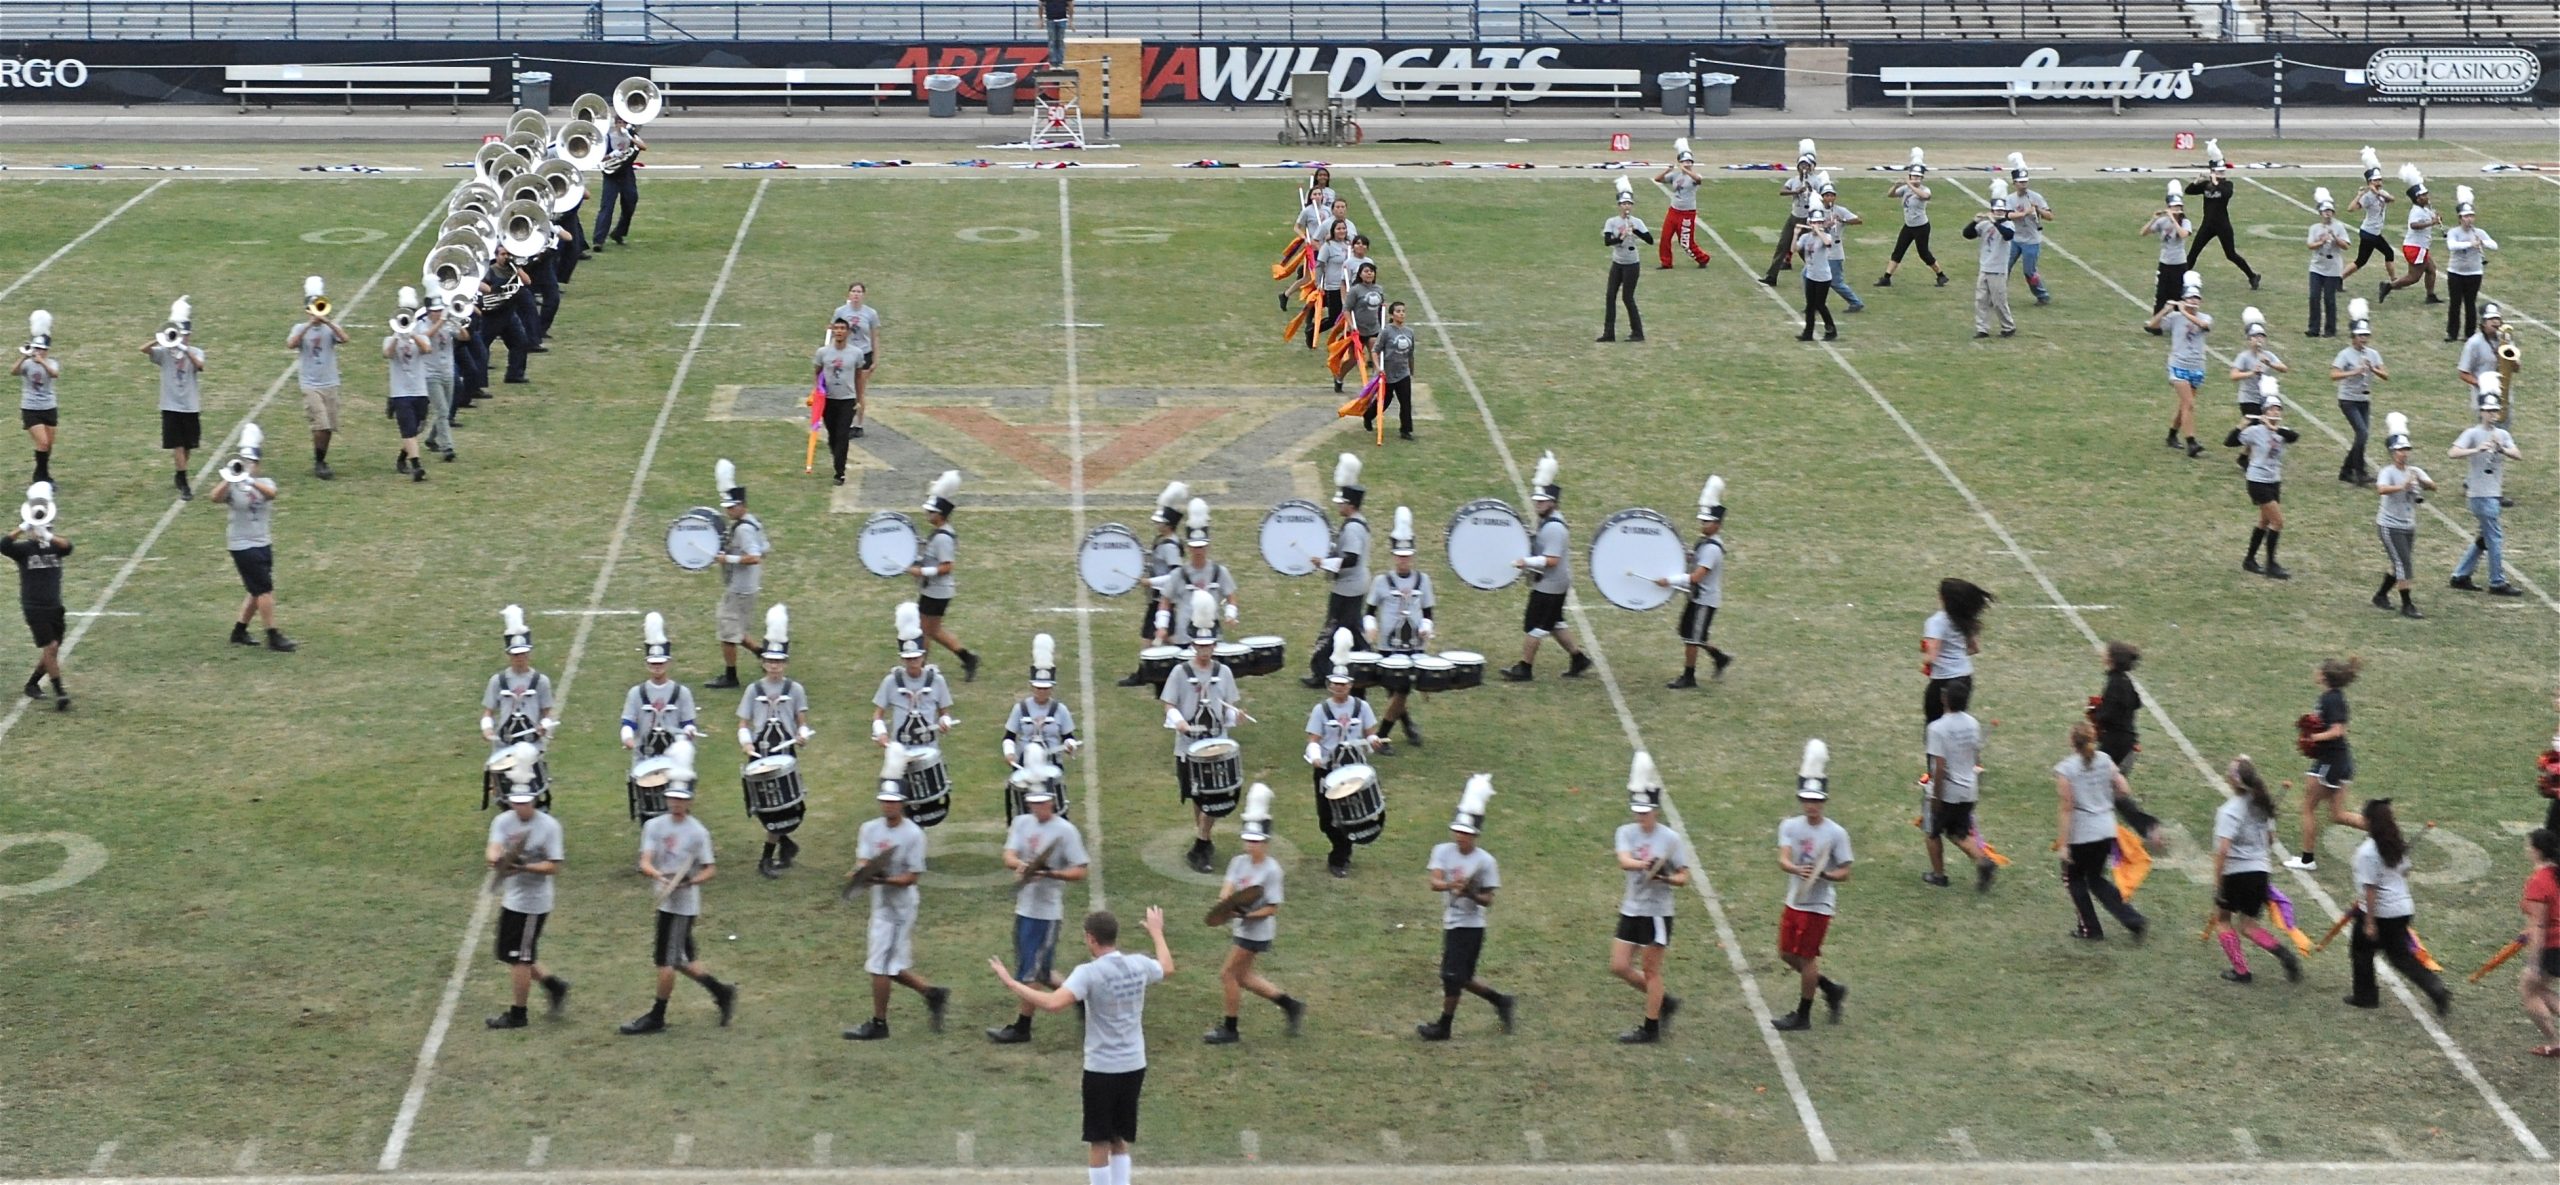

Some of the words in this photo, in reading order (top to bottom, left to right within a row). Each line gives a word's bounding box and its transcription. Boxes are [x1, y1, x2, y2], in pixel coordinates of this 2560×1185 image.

[881, 46, 1198, 101] ARIZA
[1199, 46, 1561, 102] WILDCATS
[2385, 63, 2422, 79] SOL
[2431, 62, 2523, 80] CASINOS
[1048, 106, 1065, 121] 50
[1613, 135, 1630, 150] 40
[2176, 133, 2194, 149] 30
